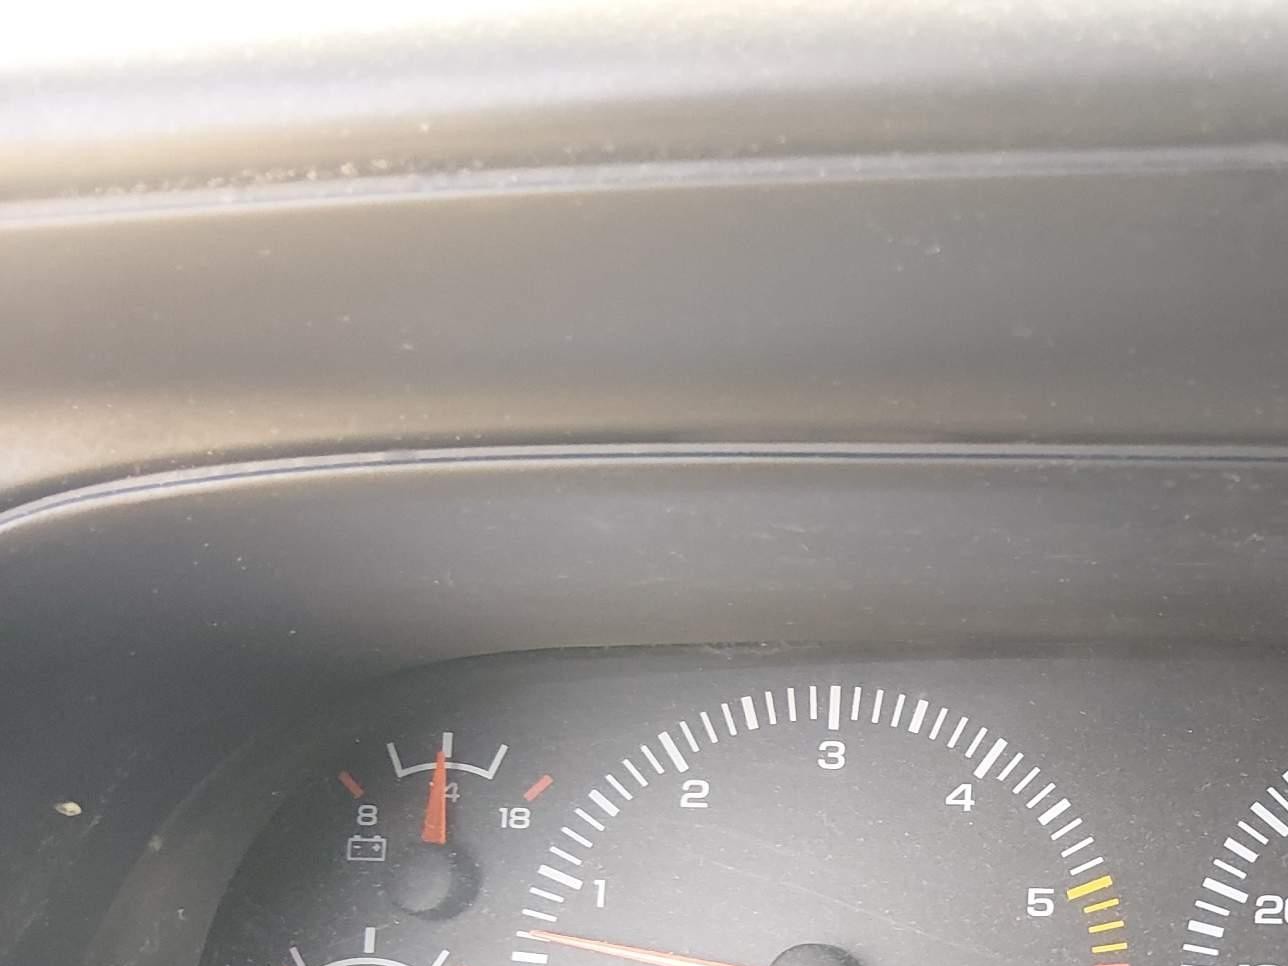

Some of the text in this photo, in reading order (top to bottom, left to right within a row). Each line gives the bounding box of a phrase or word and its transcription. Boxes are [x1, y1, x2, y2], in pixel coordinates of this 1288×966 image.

[817, 740, 846, 770] 3
[680, 779, 710, 808] 2
[945, 783, 975, 812] 4
[356, 804, 378, 826] 8
[499, 807, 531, 829] 18
[593, 879, 606, 908] 1
[1027, 887, 1055, 917] 5
